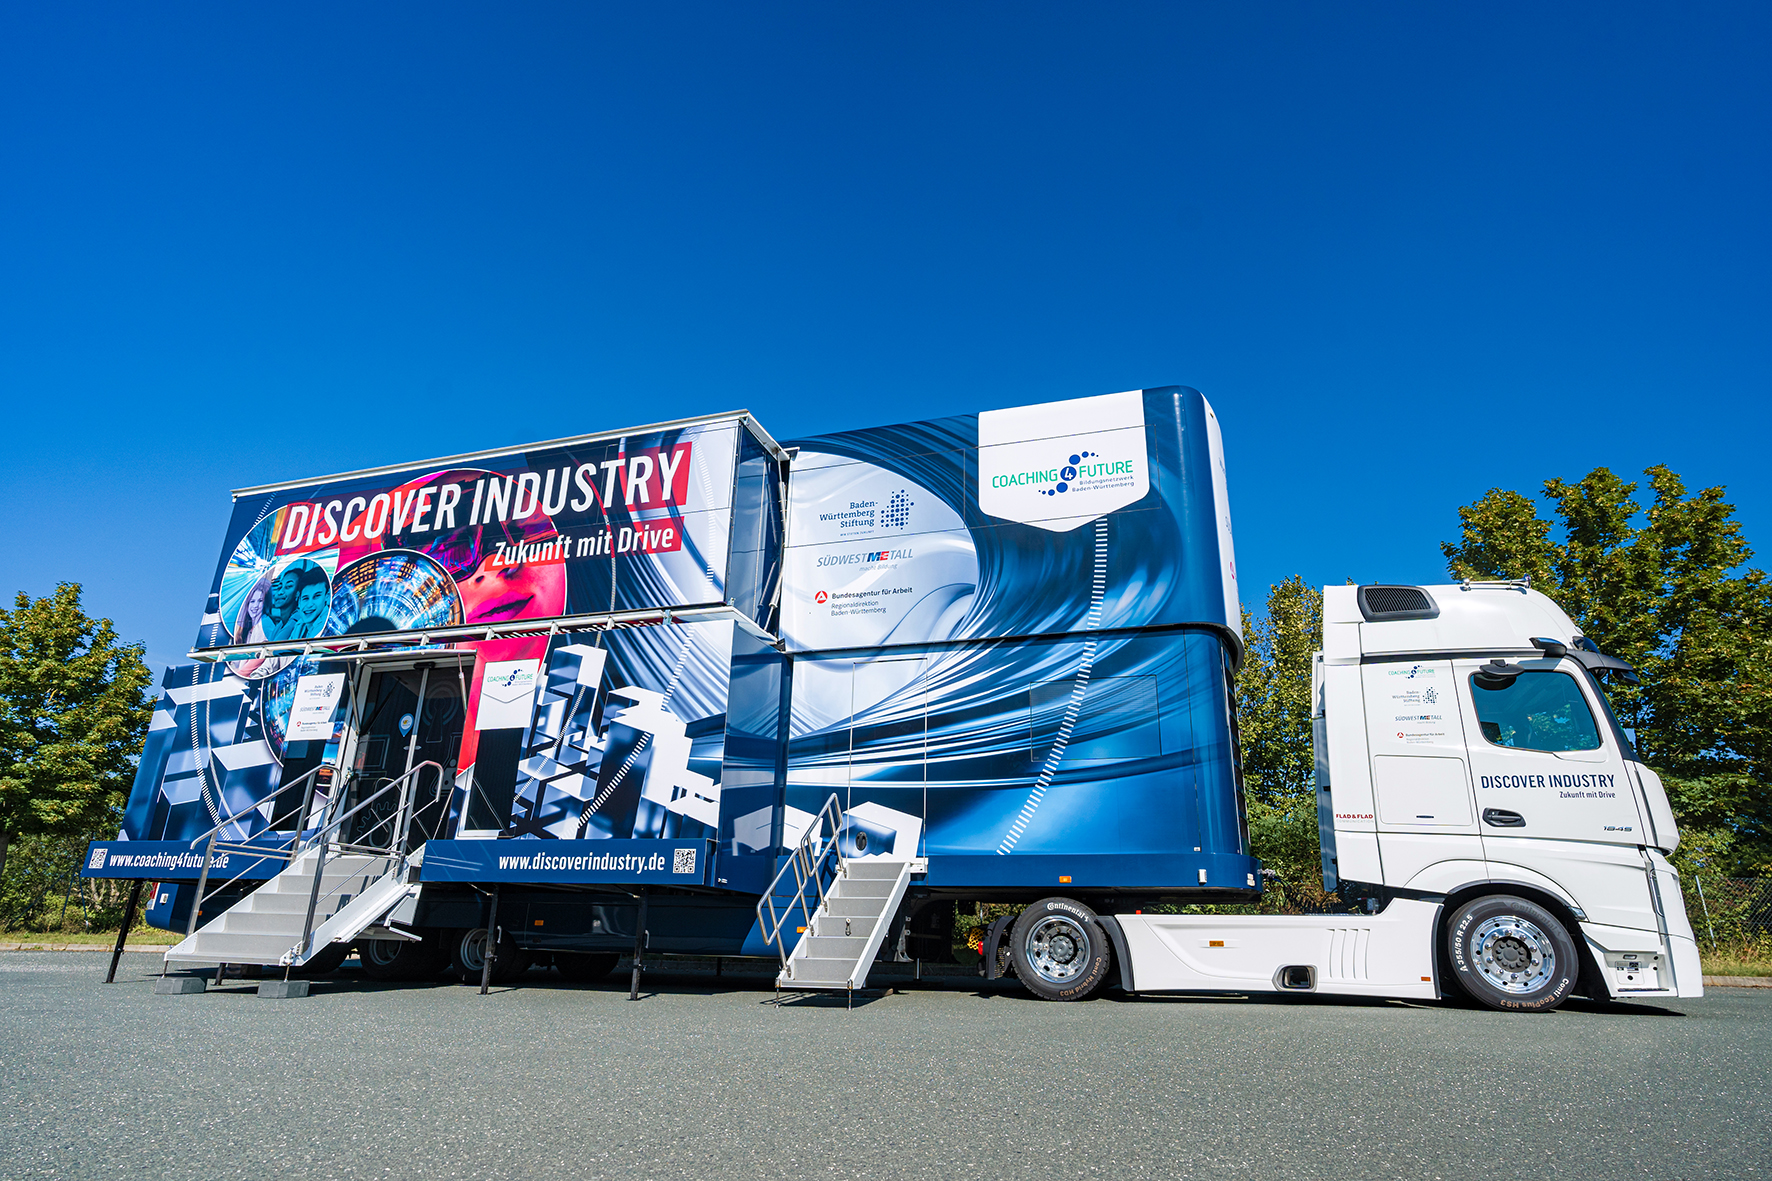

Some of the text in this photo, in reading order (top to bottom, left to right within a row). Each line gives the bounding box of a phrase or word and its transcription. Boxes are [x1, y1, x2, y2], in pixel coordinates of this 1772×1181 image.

[992, 468, 1058, 489] COACHING
[1079, 460, 1134, 478] FUTURE
[1079, 474, 1134, 485] Bildungsnetzwerk
[1072, 481, 1135, 492] Baden-Württemberg
[282, 449, 685, 550] DISCOVER INDUSTRY
[849, 500, 878, 510] Baden-
[819, 509, 875, 521] Württemberg
[840, 518, 875, 529] Stiftung
[492, 524, 675, 567] Zukunft mit Drive
[816, 548, 914, 567] SÜDWESTMETALL
[831, 590, 881, 600] Bundesagentur
[892, 586, 913, 594] Arbeit
[831, 600, 879, 609] Regionaldirektion
[831, 607, 887, 616] Baden-Württemberg
[1480, 774, 1615, 789] DISCOVER INDUSTRY
[1559, 790, 1616, 799] Zukunft mit Drive
[109, 851, 230, 871] www.coaching4futue.de
[499, 852, 666, 874] www.discoverindustry.de
[1046, 902, 1085, 919] Continental
[1460, 914, 1474, 930] 22.5
[1457, 929, 1464, 937] R
[1092, 956, 1102, 976] Conti
[1075, 975, 1095, 991] Hybrid
[1500, 977, 1570, 1009] Conti EcoPlus HS3
